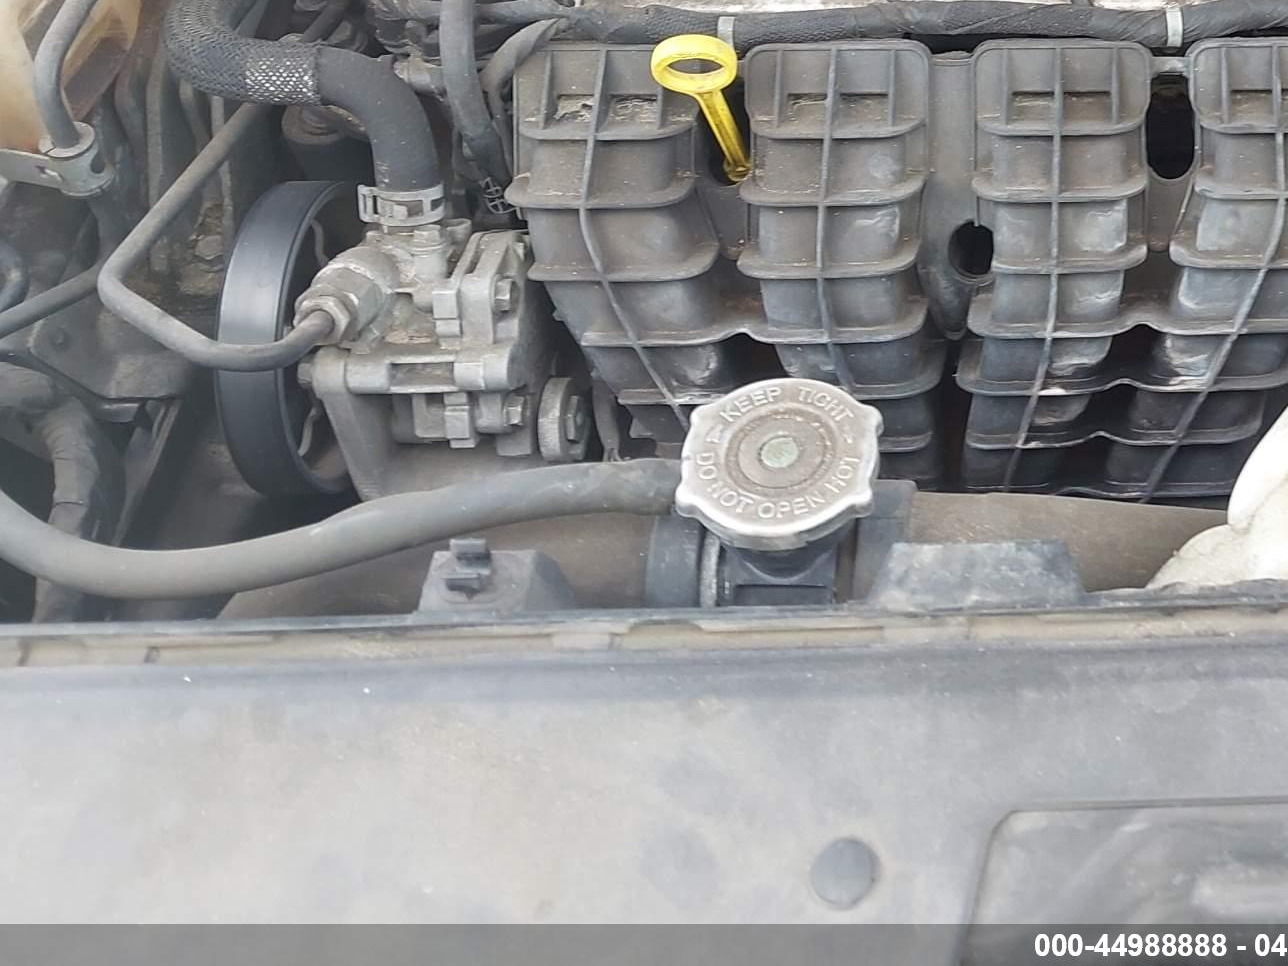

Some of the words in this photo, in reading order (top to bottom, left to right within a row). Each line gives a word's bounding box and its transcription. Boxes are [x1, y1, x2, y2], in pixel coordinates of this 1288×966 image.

[719, 386, 784, 423] KEEP
[797, 386, 854, 422] TIGHT
[695, 452, 718, 480] DO
[826, 456, 861, 495] HOT
[706, 482, 754, 514] NOT
[757, 490, 826, 519] OPEN
